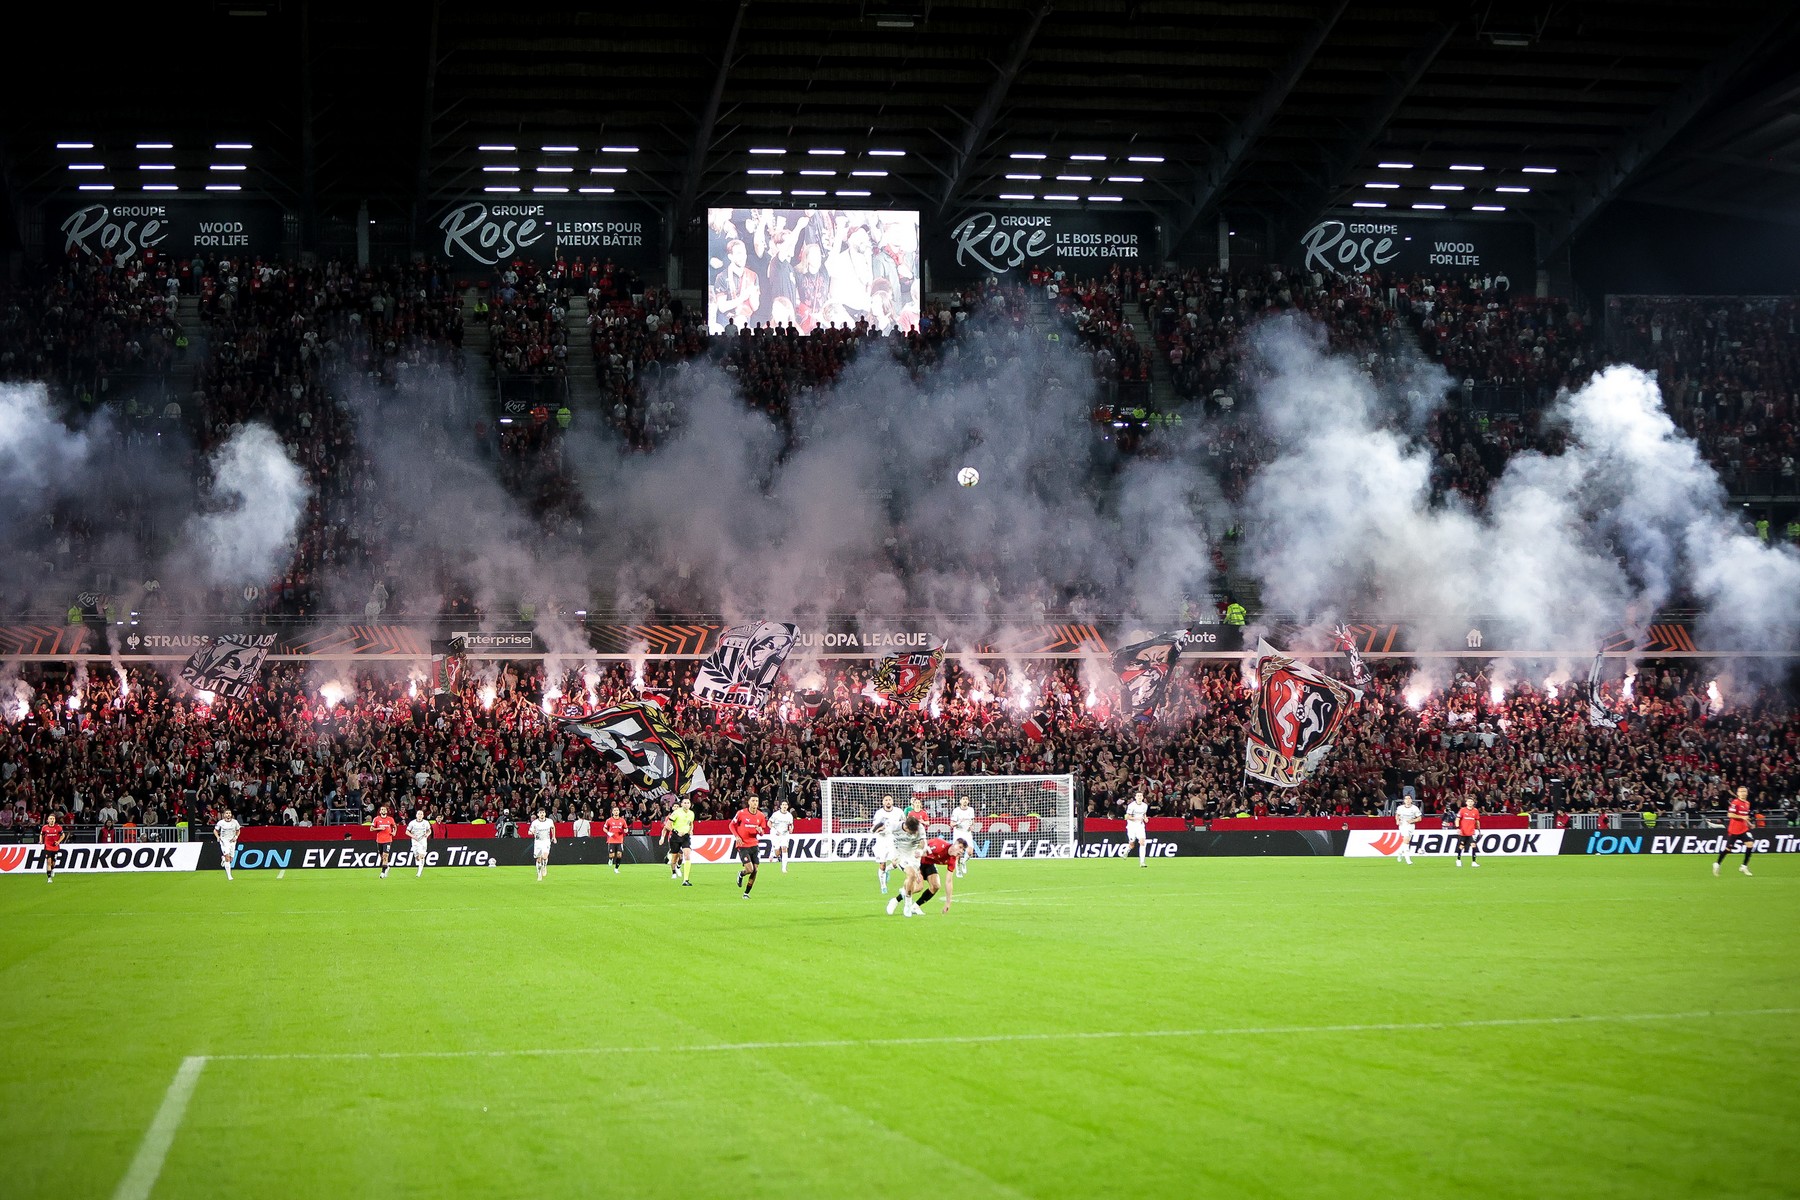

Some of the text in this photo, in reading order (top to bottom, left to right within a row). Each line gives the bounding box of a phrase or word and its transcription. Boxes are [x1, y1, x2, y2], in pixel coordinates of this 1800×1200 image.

[113, 207, 166, 216] GROUPE
[492, 206, 544, 216] GROUPE
[557, 222, 642, 232] LE BOIS POUR
[1001, 216, 1051, 226] GROUPE
[61, 204, 168, 263] Rose
[200, 222, 242, 233] WOOD
[439, 202, 545, 264] Rose
[1350, 224, 1398, 234] GROUPE
[194, 236, 248, 246] FOR LIFE
[557, 234, 642, 246] MIEUX BÂTIR
[951, 212, 1054, 273] Rose
[1057, 234, 1138, 244] LE BOIS POUR
[1057, 245, 1138, 257] MIEUX BÂTIR
[1301, 220, 1400, 276] Rose
[1434, 242, 1474, 253] WOOD
[1430, 254, 1479, 266] FOR LIFE
[505, 400, 526, 414] Rose
[143, 635, 209, 647] STRAUSS
[863, 633, 927, 646] LEAGUE
[1000, 840, 1032, 858] EV
[1587, 832, 1643, 854] iON
[1651, 836, 1681, 854] EV
[1775, 834, 1800, 852] Tir
[302, 848, 335, 867] EV
[447, 846, 489, 866] Tire
